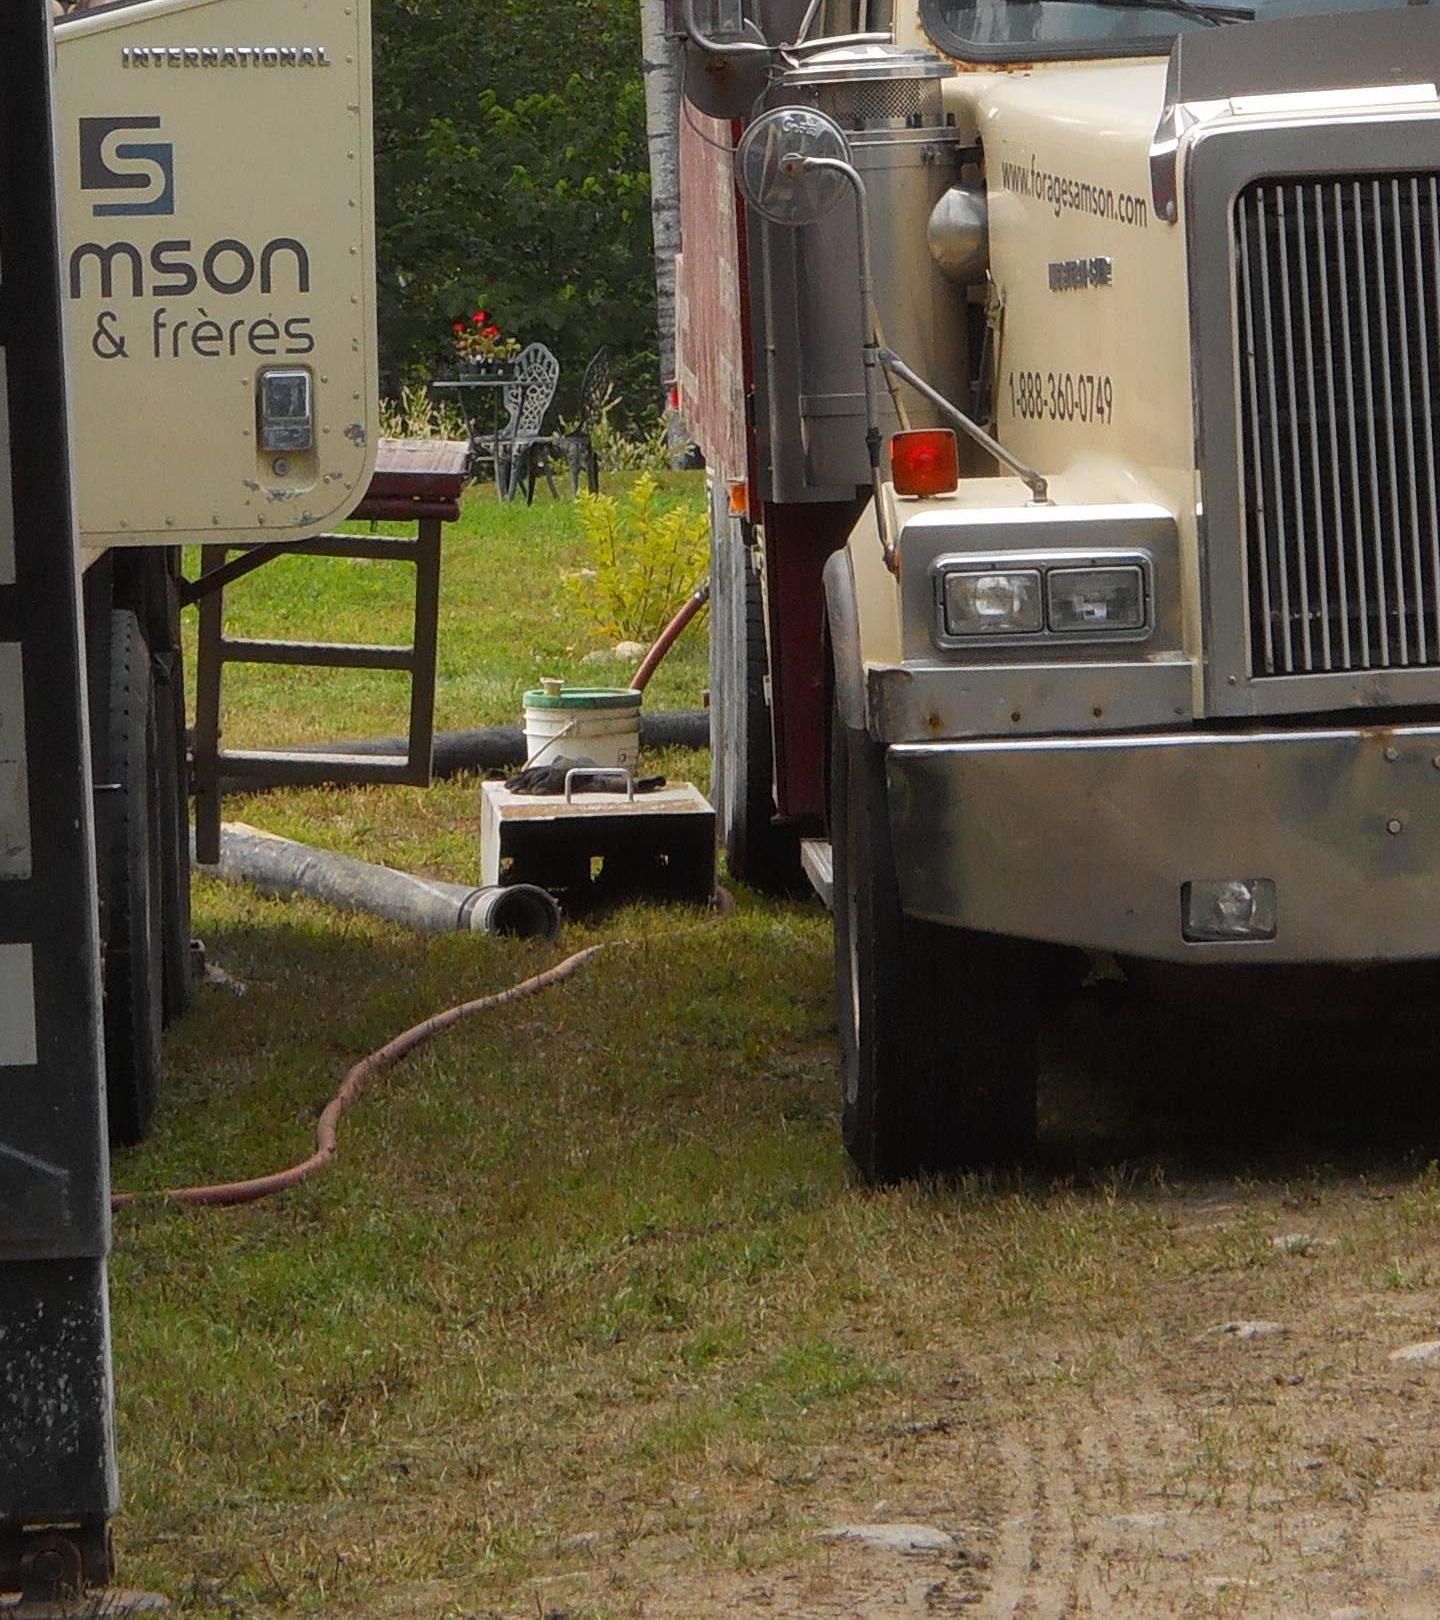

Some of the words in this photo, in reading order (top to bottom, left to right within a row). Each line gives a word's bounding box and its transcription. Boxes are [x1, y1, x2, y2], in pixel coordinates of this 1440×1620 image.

[121, 47, 332, 69] INTERNATIONAL
[1001, 154, 1148, 228] www.foragesamson.com
[69, 237, 310, 299] mson
[92, 311, 129, 359] &
[1009, 372, 1113, 425] 1-888-360-0749
